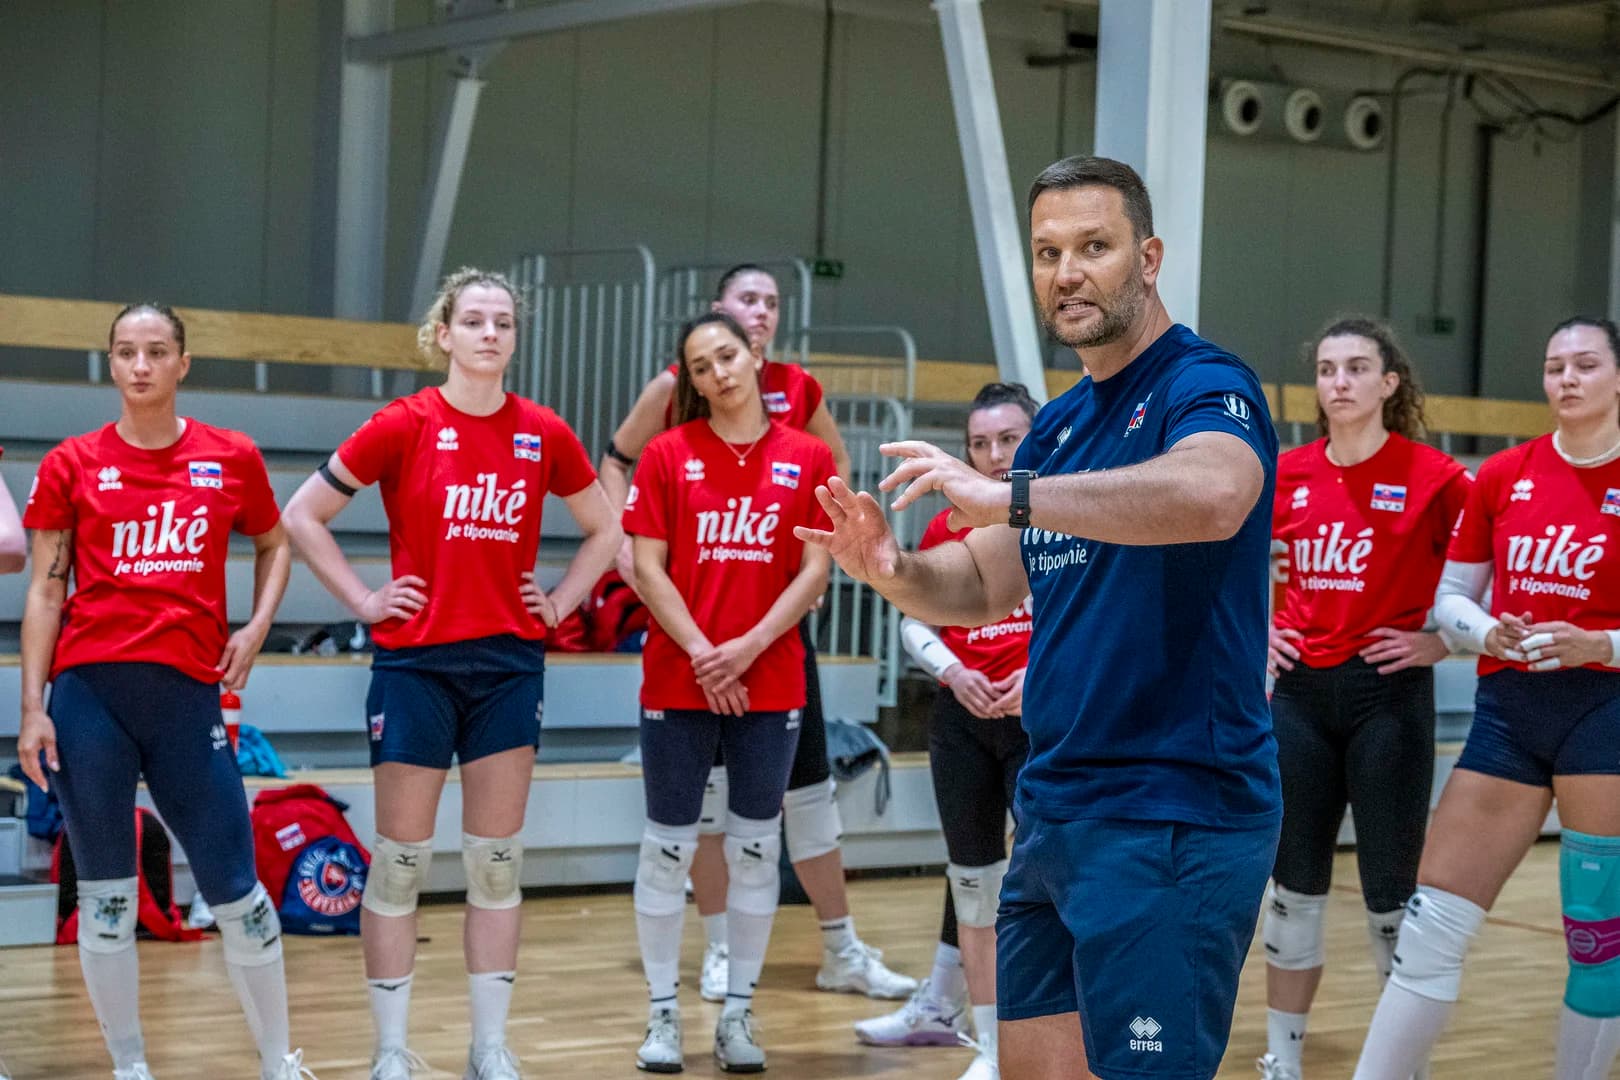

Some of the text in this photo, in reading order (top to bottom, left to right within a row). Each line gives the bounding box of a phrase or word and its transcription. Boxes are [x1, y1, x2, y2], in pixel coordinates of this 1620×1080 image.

[443, 472, 527, 525] niké
[111, 500, 209, 558] niké
[445, 522, 519, 543] je tipovanie
[696, 496, 781, 546] niké
[697, 545, 773, 564] je tipovanie
[1293, 521, 1374, 574] niké
[1506, 524, 1607, 580] niké
[113, 557, 204, 576] je tipovanie
[1520, 576, 1591, 600] tipovanie
[981, 620, 1033, 640] tipovan
[1130, 1039, 1162, 1052] errea
